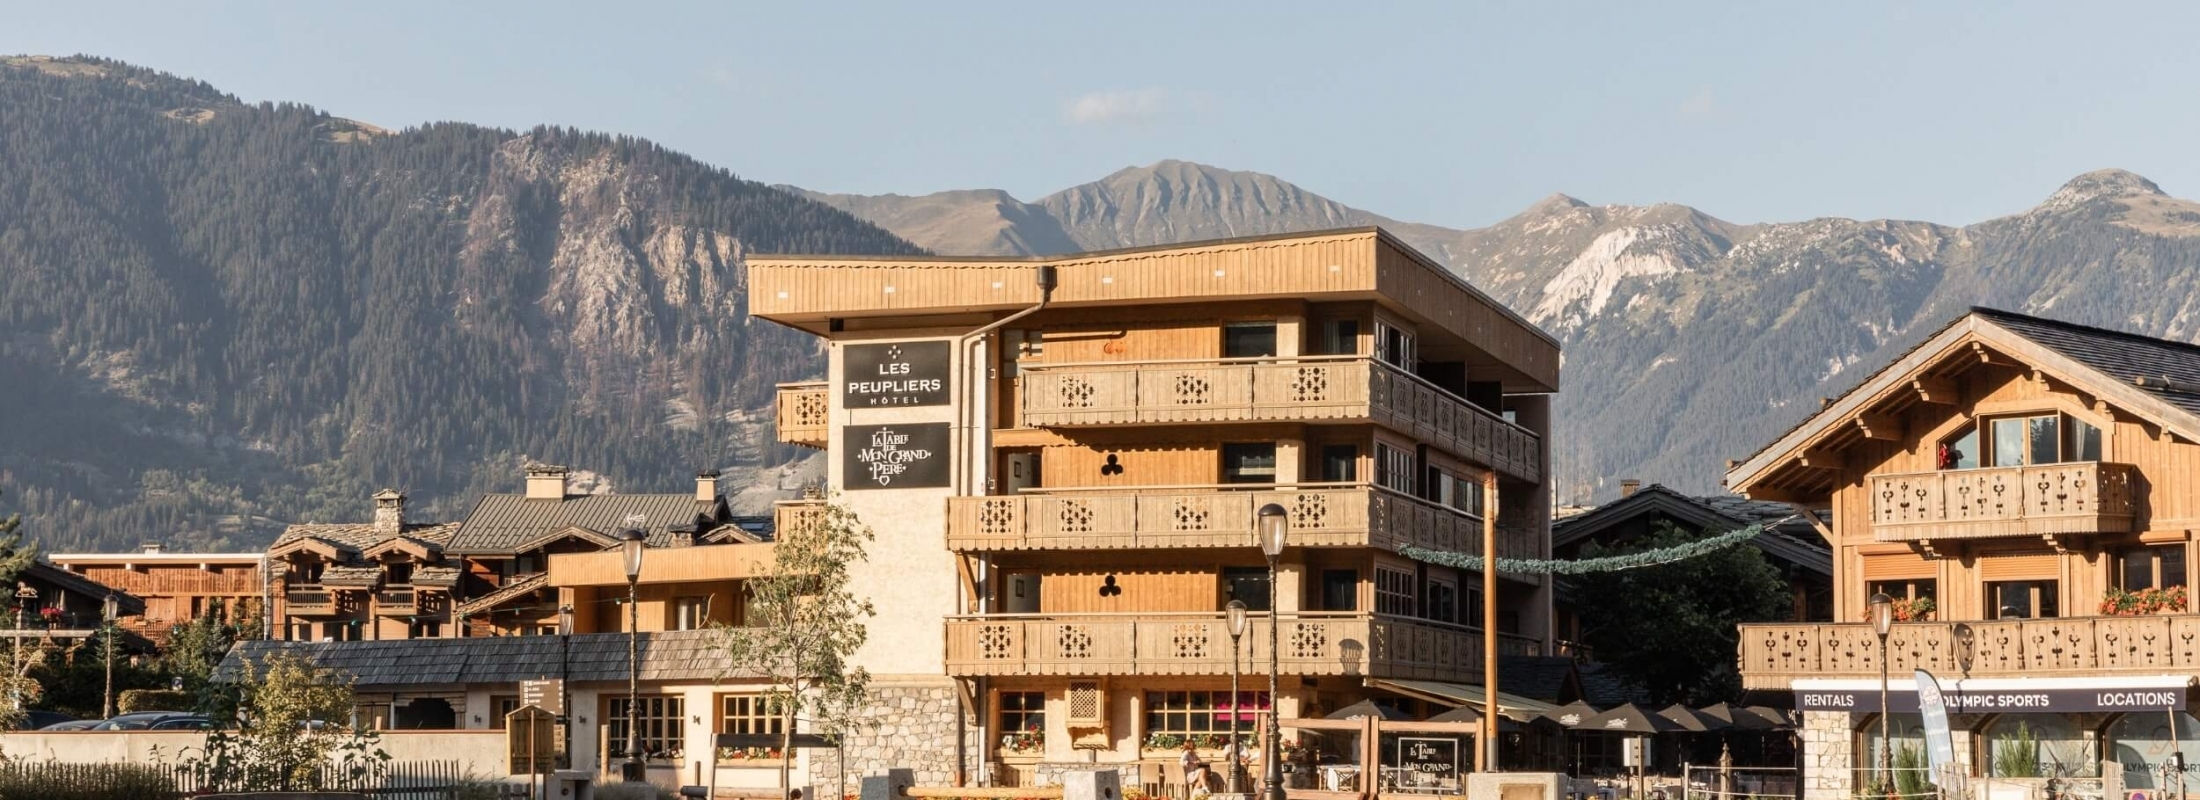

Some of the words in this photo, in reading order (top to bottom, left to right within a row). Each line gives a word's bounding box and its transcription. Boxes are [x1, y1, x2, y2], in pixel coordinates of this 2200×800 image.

[879, 363, 910, 375] LES
[848, 379, 941, 394] PEUPLIERS
[870, 396, 919, 405] HÔTEL
[888, 449, 928, 464] GRAND
[872, 460, 903, 480] PÈRE
[1804, 694, 1854, 707] RENTALS
[1998, 695, 2049, 707] SPORTS
[2097, 692, 2176, 706] LOCATIONS
[2125, 763, 2163, 773] LYMPI
